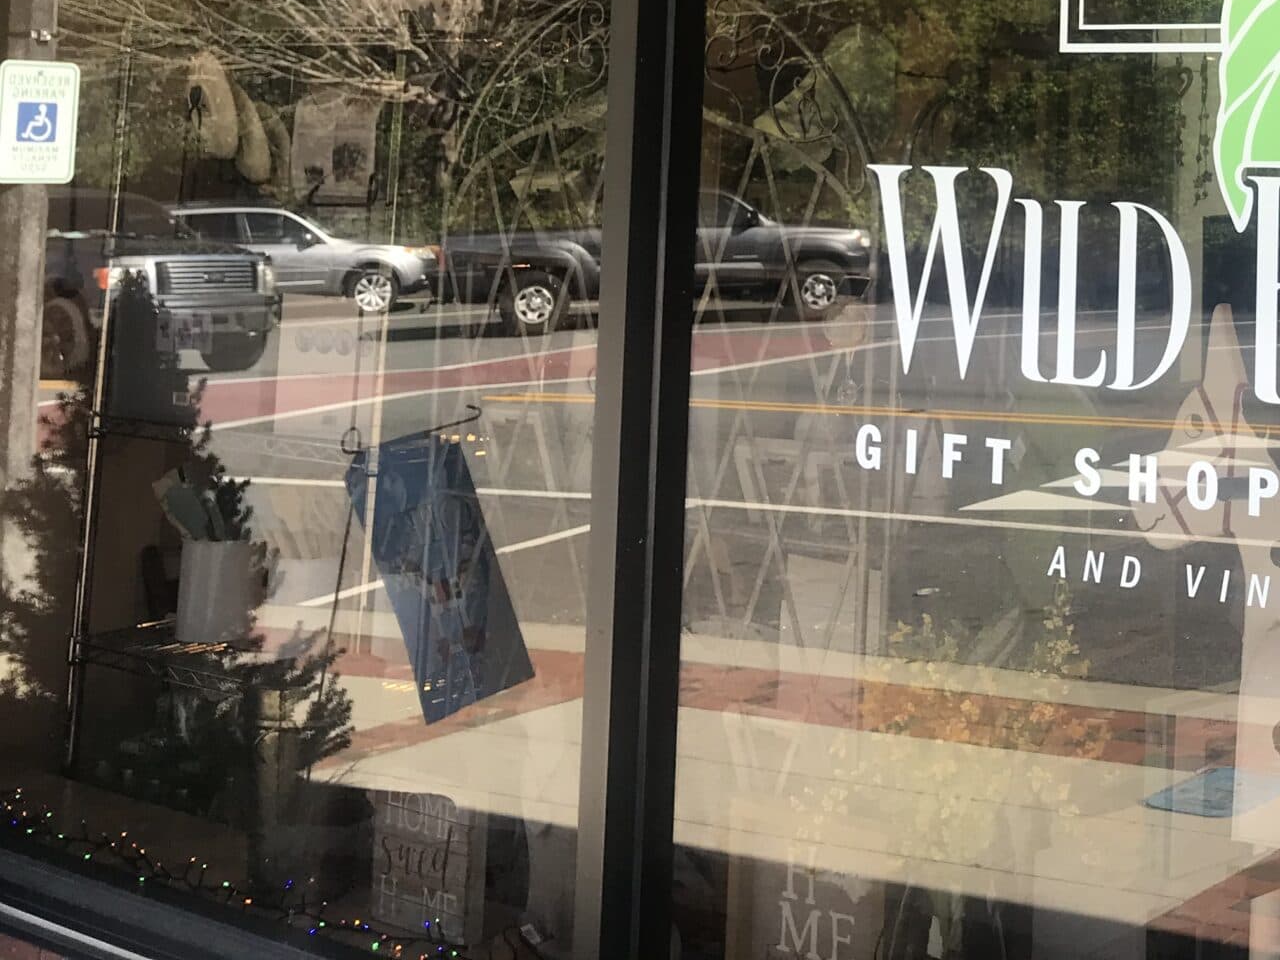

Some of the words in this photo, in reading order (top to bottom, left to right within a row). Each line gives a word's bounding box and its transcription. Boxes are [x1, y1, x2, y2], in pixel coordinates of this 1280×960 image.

[867, 164, 1192, 390] WILD
[855, 424, 1011, 485] GIFT
[1074, 448, 1279, 517] SHOP
[1048, 546, 1141, 588] AND
